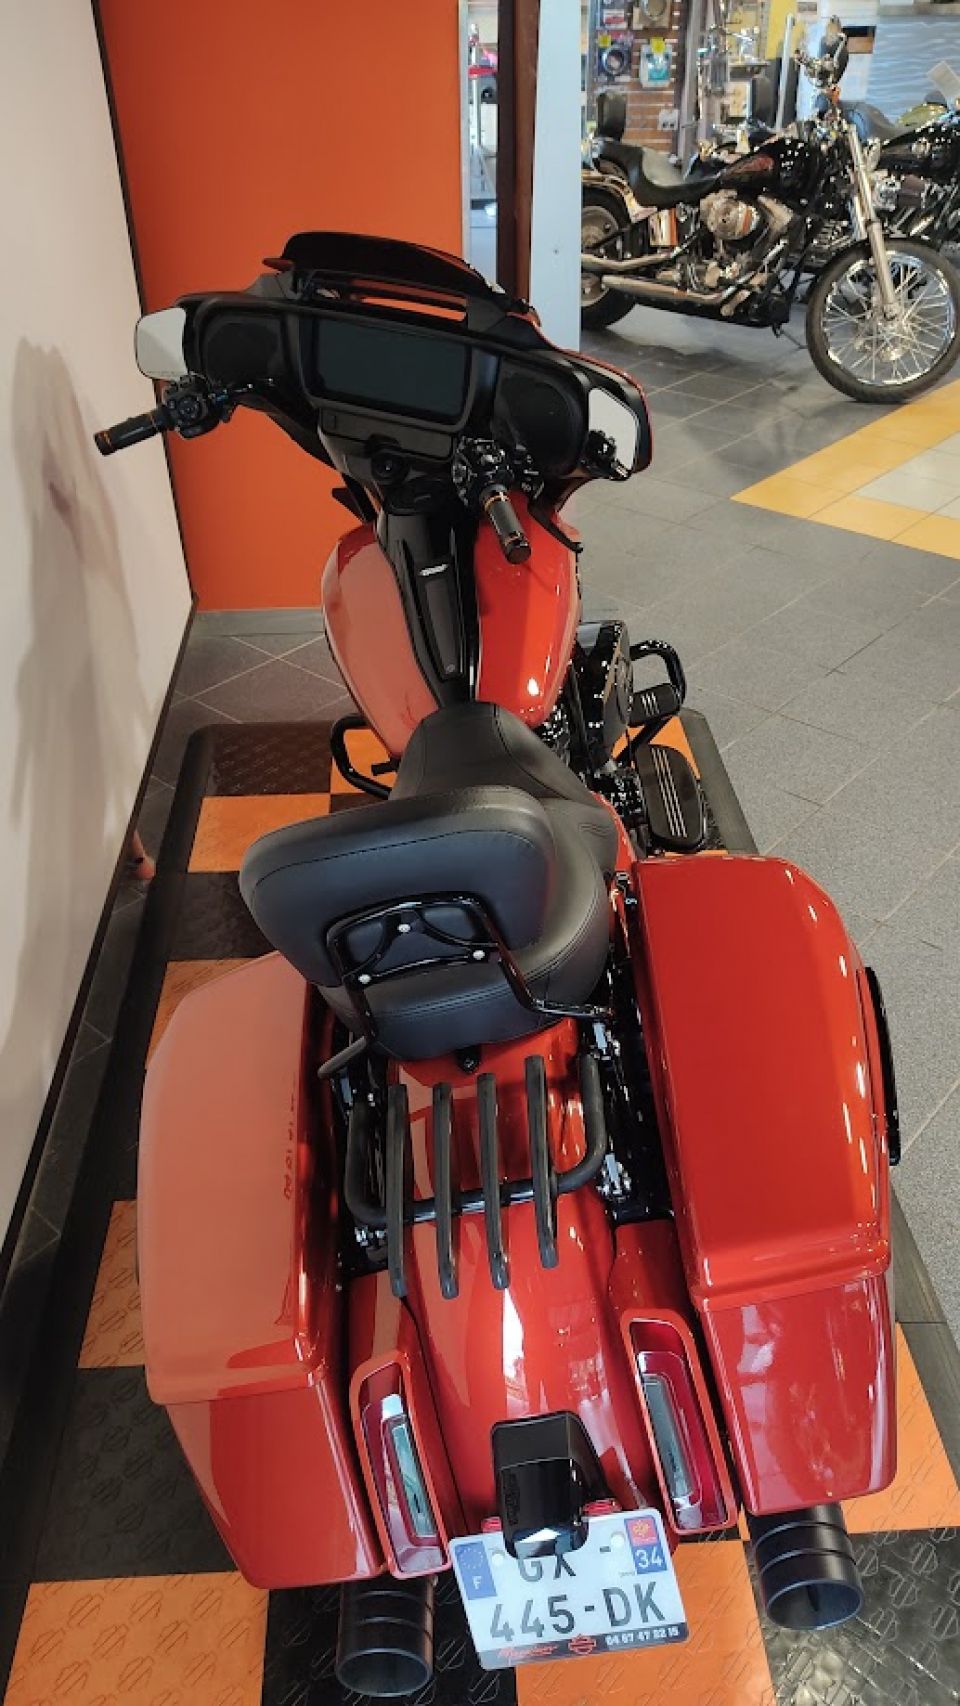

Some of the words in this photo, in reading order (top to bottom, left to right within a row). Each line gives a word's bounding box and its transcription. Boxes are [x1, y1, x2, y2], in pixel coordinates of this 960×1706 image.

[635, 1548, 664, 1569] 34
[472, 1575, 482, 1590] F
[489, 1581, 666, 1643] 445-DK
